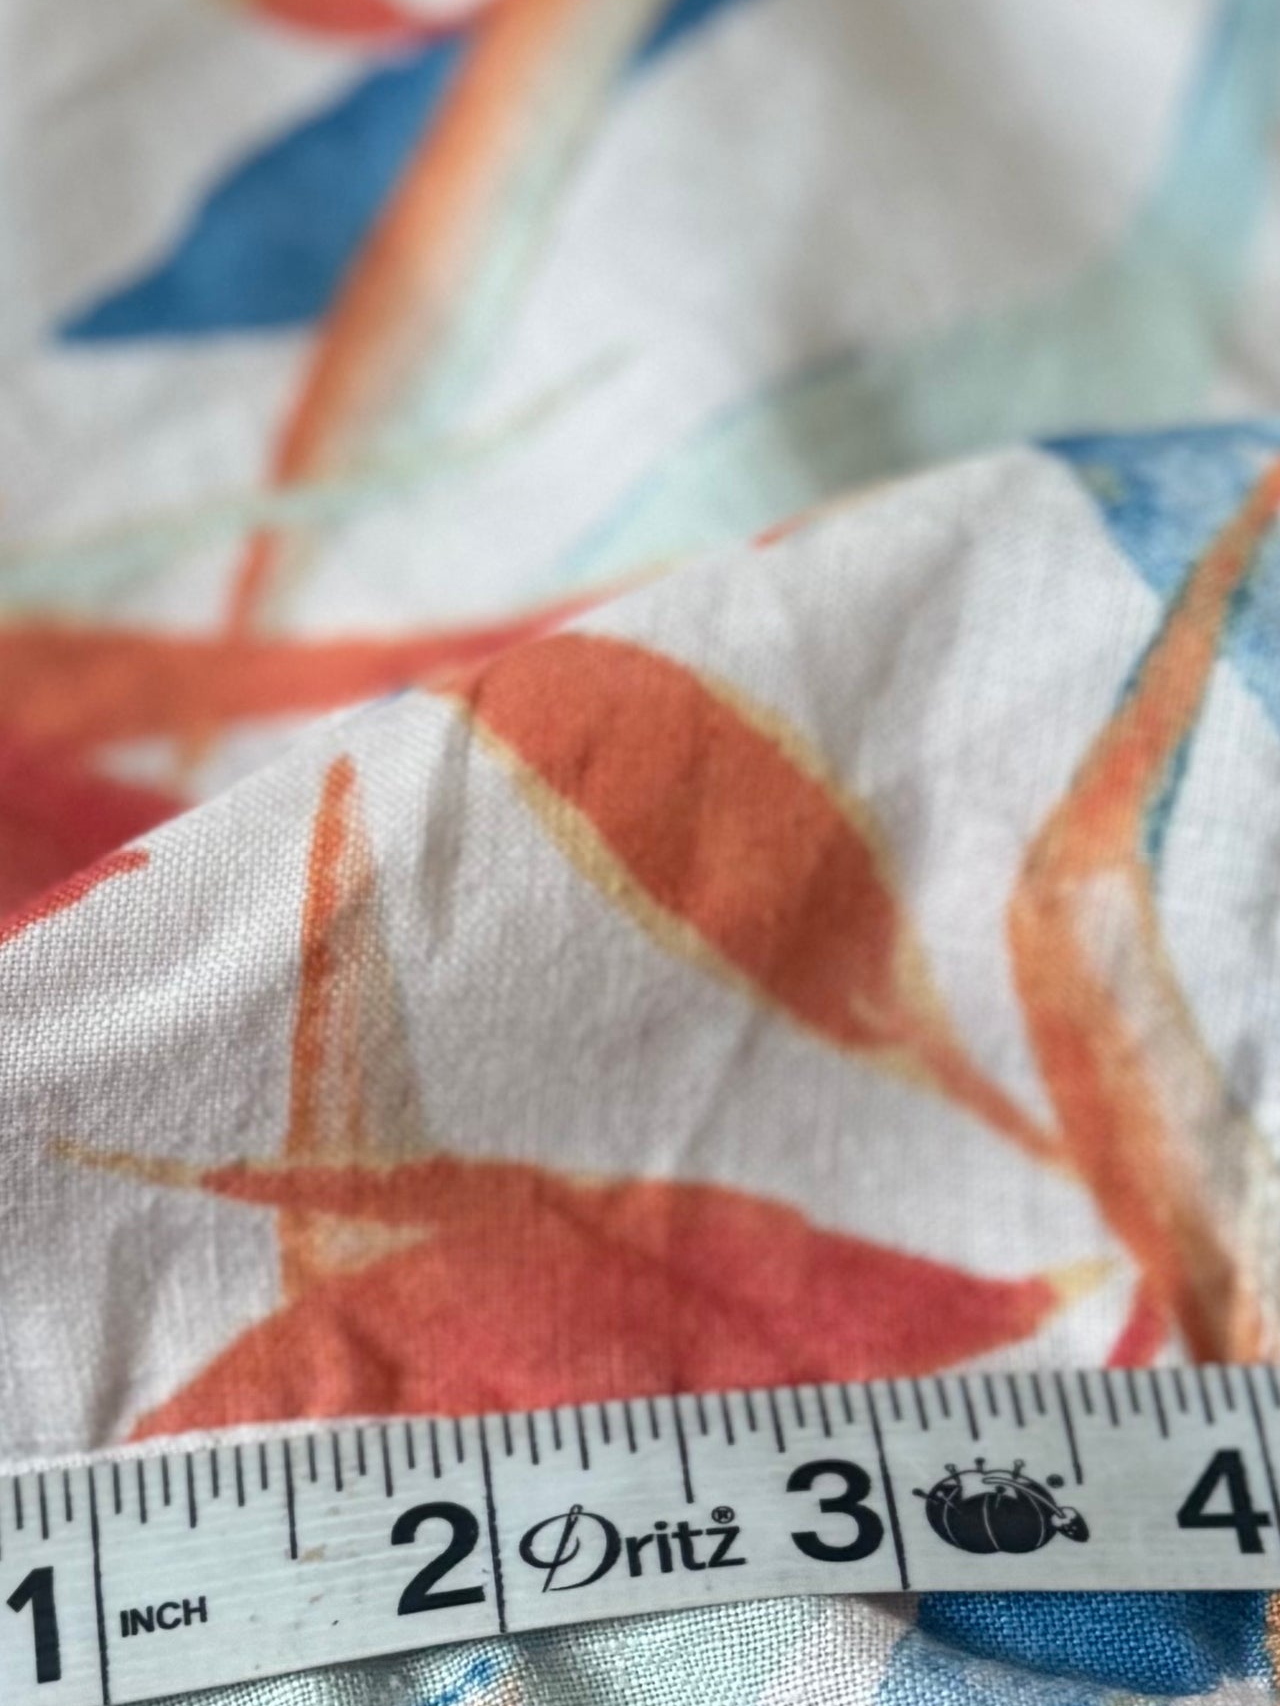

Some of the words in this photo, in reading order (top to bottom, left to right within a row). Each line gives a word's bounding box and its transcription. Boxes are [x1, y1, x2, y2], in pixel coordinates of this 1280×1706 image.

[6, 1566, 62, 1684] 1
[120, 1595, 209, 1638] INCH
[390, 1501, 487, 1617] 2
[785, 1459, 885, 1563] 3
[1176, 1448, 1271, 1556] 4
